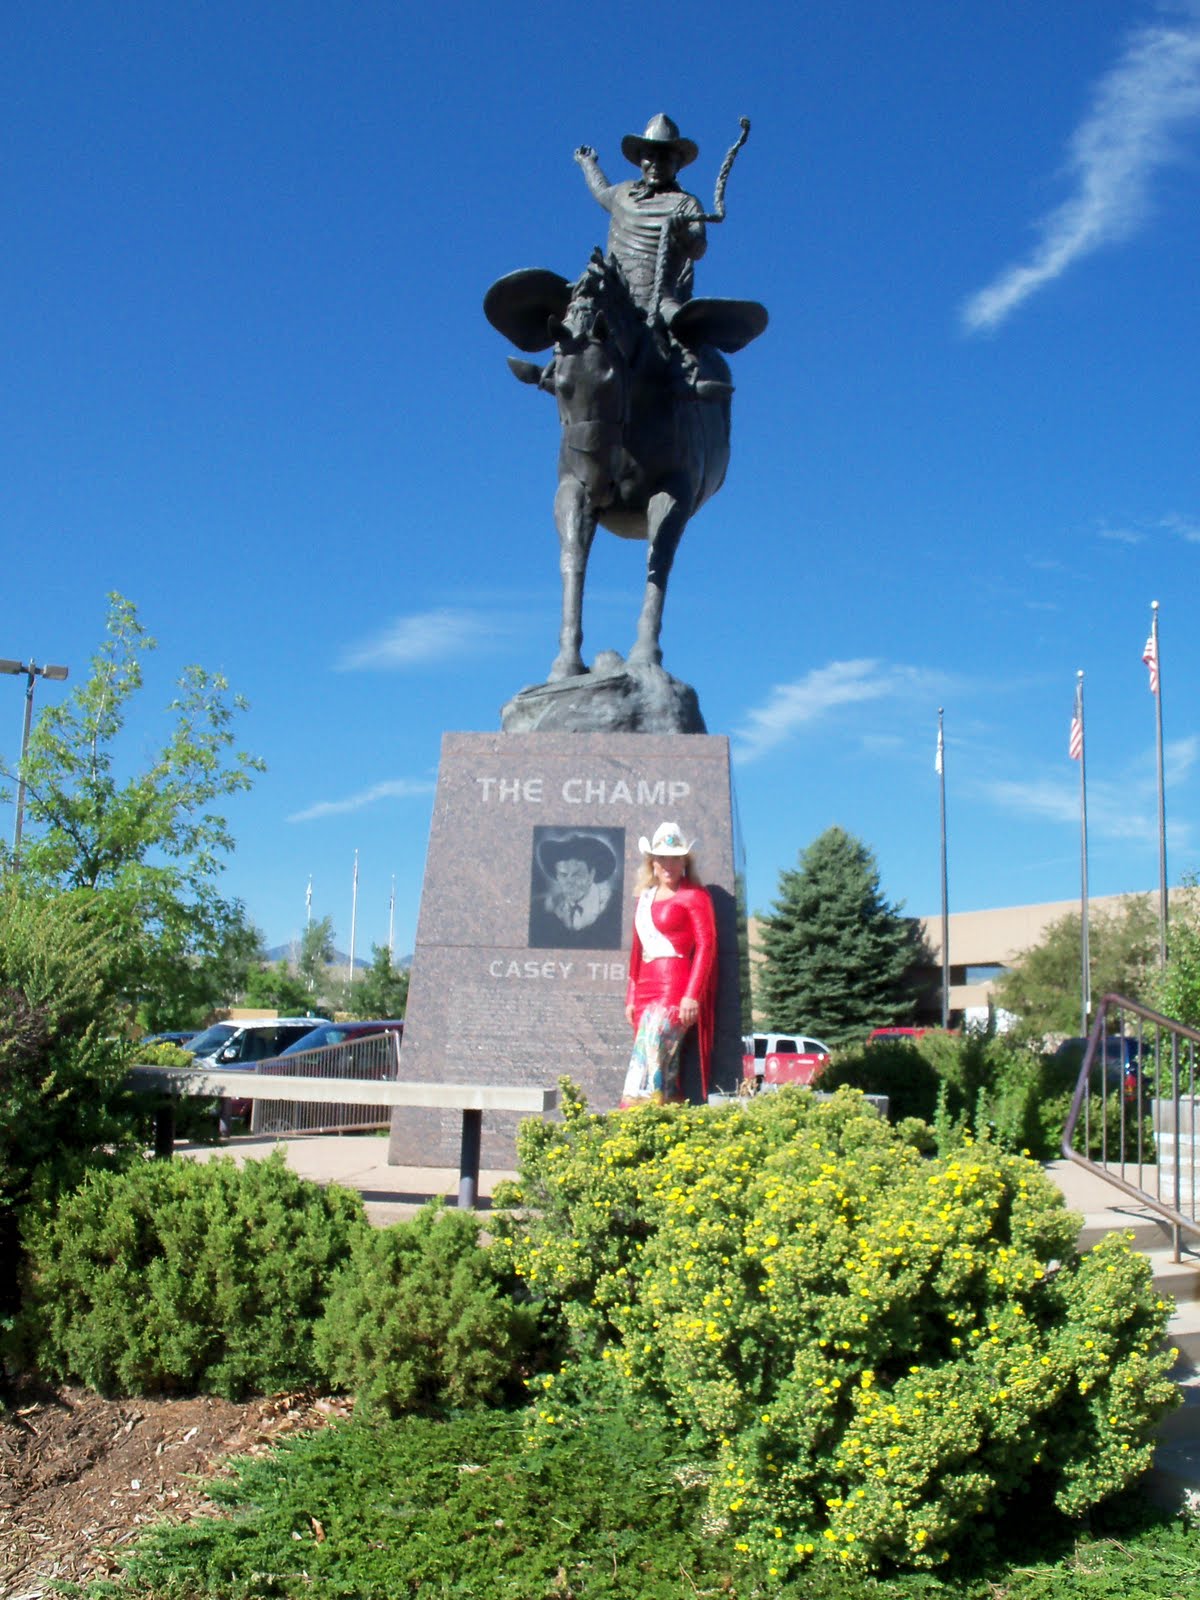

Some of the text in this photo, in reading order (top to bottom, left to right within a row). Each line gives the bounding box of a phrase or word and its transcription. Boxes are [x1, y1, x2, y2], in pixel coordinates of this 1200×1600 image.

[476, 777, 691, 806] THE CHAMP
[489, 960, 574, 980] CASEY
